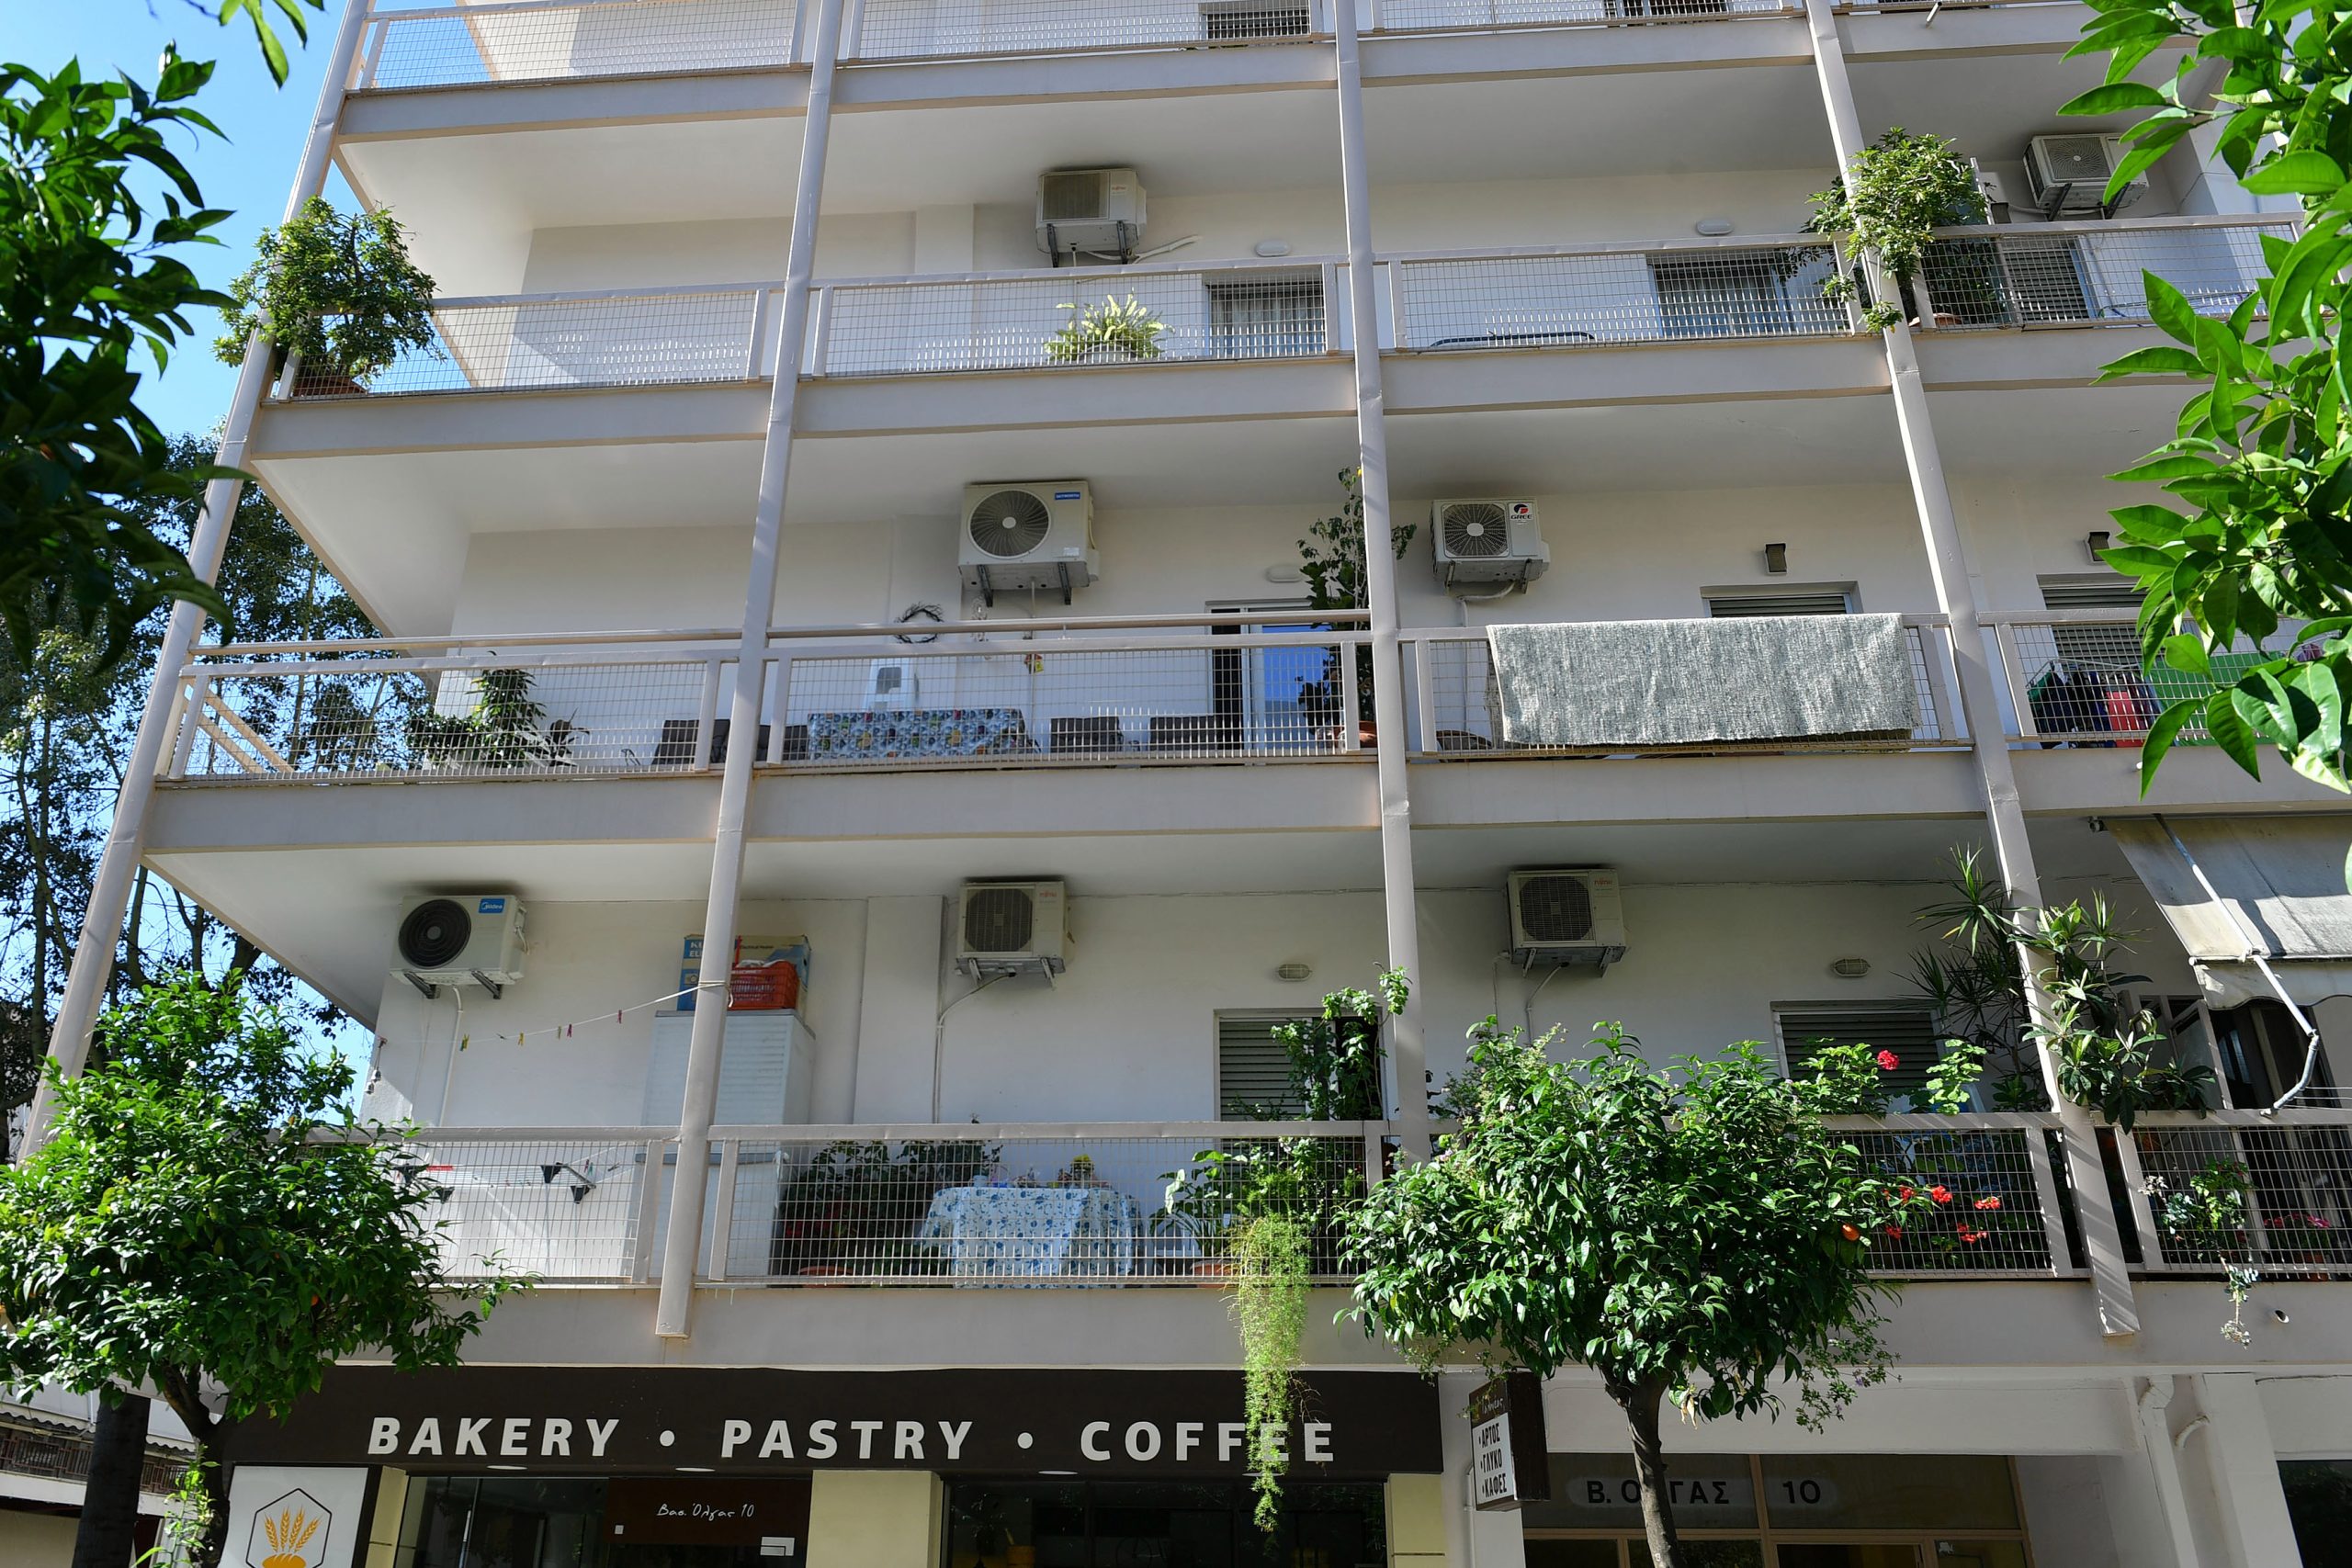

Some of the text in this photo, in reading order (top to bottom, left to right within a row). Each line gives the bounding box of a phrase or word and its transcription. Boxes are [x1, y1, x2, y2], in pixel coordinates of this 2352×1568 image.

[368, 1417, 620, 1457] BAKERY
[720, 1419, 974, 1460] PASTRY
[1621, 1480, 1730, 1505] ΟΓΑΣ
[1782, 1480, 1821, 1504] 10
[741, 1504, 754, 1517] 10
